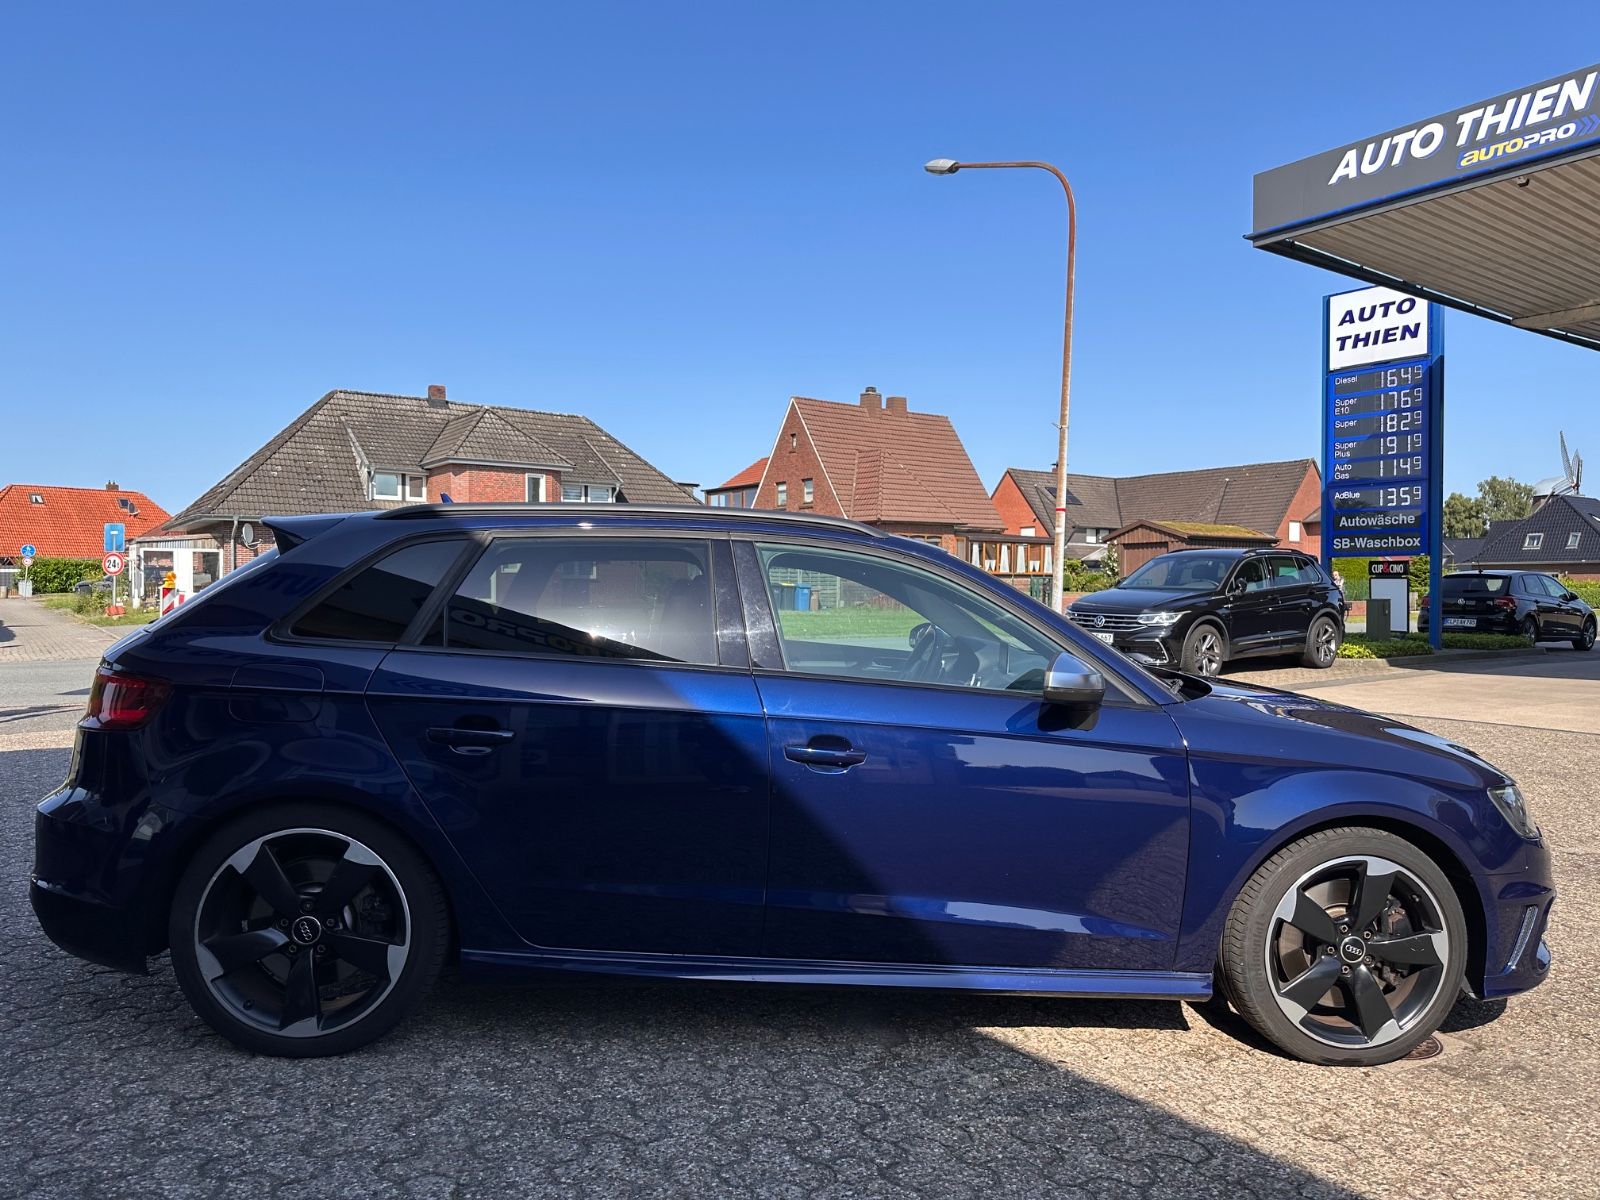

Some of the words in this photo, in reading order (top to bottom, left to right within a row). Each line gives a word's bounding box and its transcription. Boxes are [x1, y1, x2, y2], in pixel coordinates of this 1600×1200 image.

[1328, 122, 1445, 185] AUTO
[1455, 71, 1599, 147] THIEN
[1337, 297, 1417, 327] AUTO
[1336, 322, 1421, 352] THIEN
[1334, 375, 1358, 385] Diesel
[1334, 397, 1358, 408] Super
[1334, 406, 1350, 416] E10
[1334, 420, 1358, 429] Super
[1334, 441, 1357, 451] Super
[1334, 450, 1351, 459] Plus
[1334, 463, 1352, 472] Auto
[1334, 472, 1350, 480] Gas
[1334, 491, 1361, 500] AdBlue
[1339, 513, 1416, 528] Autowäsche
[1333, 536, 1421, 549] SB-Waschbox
